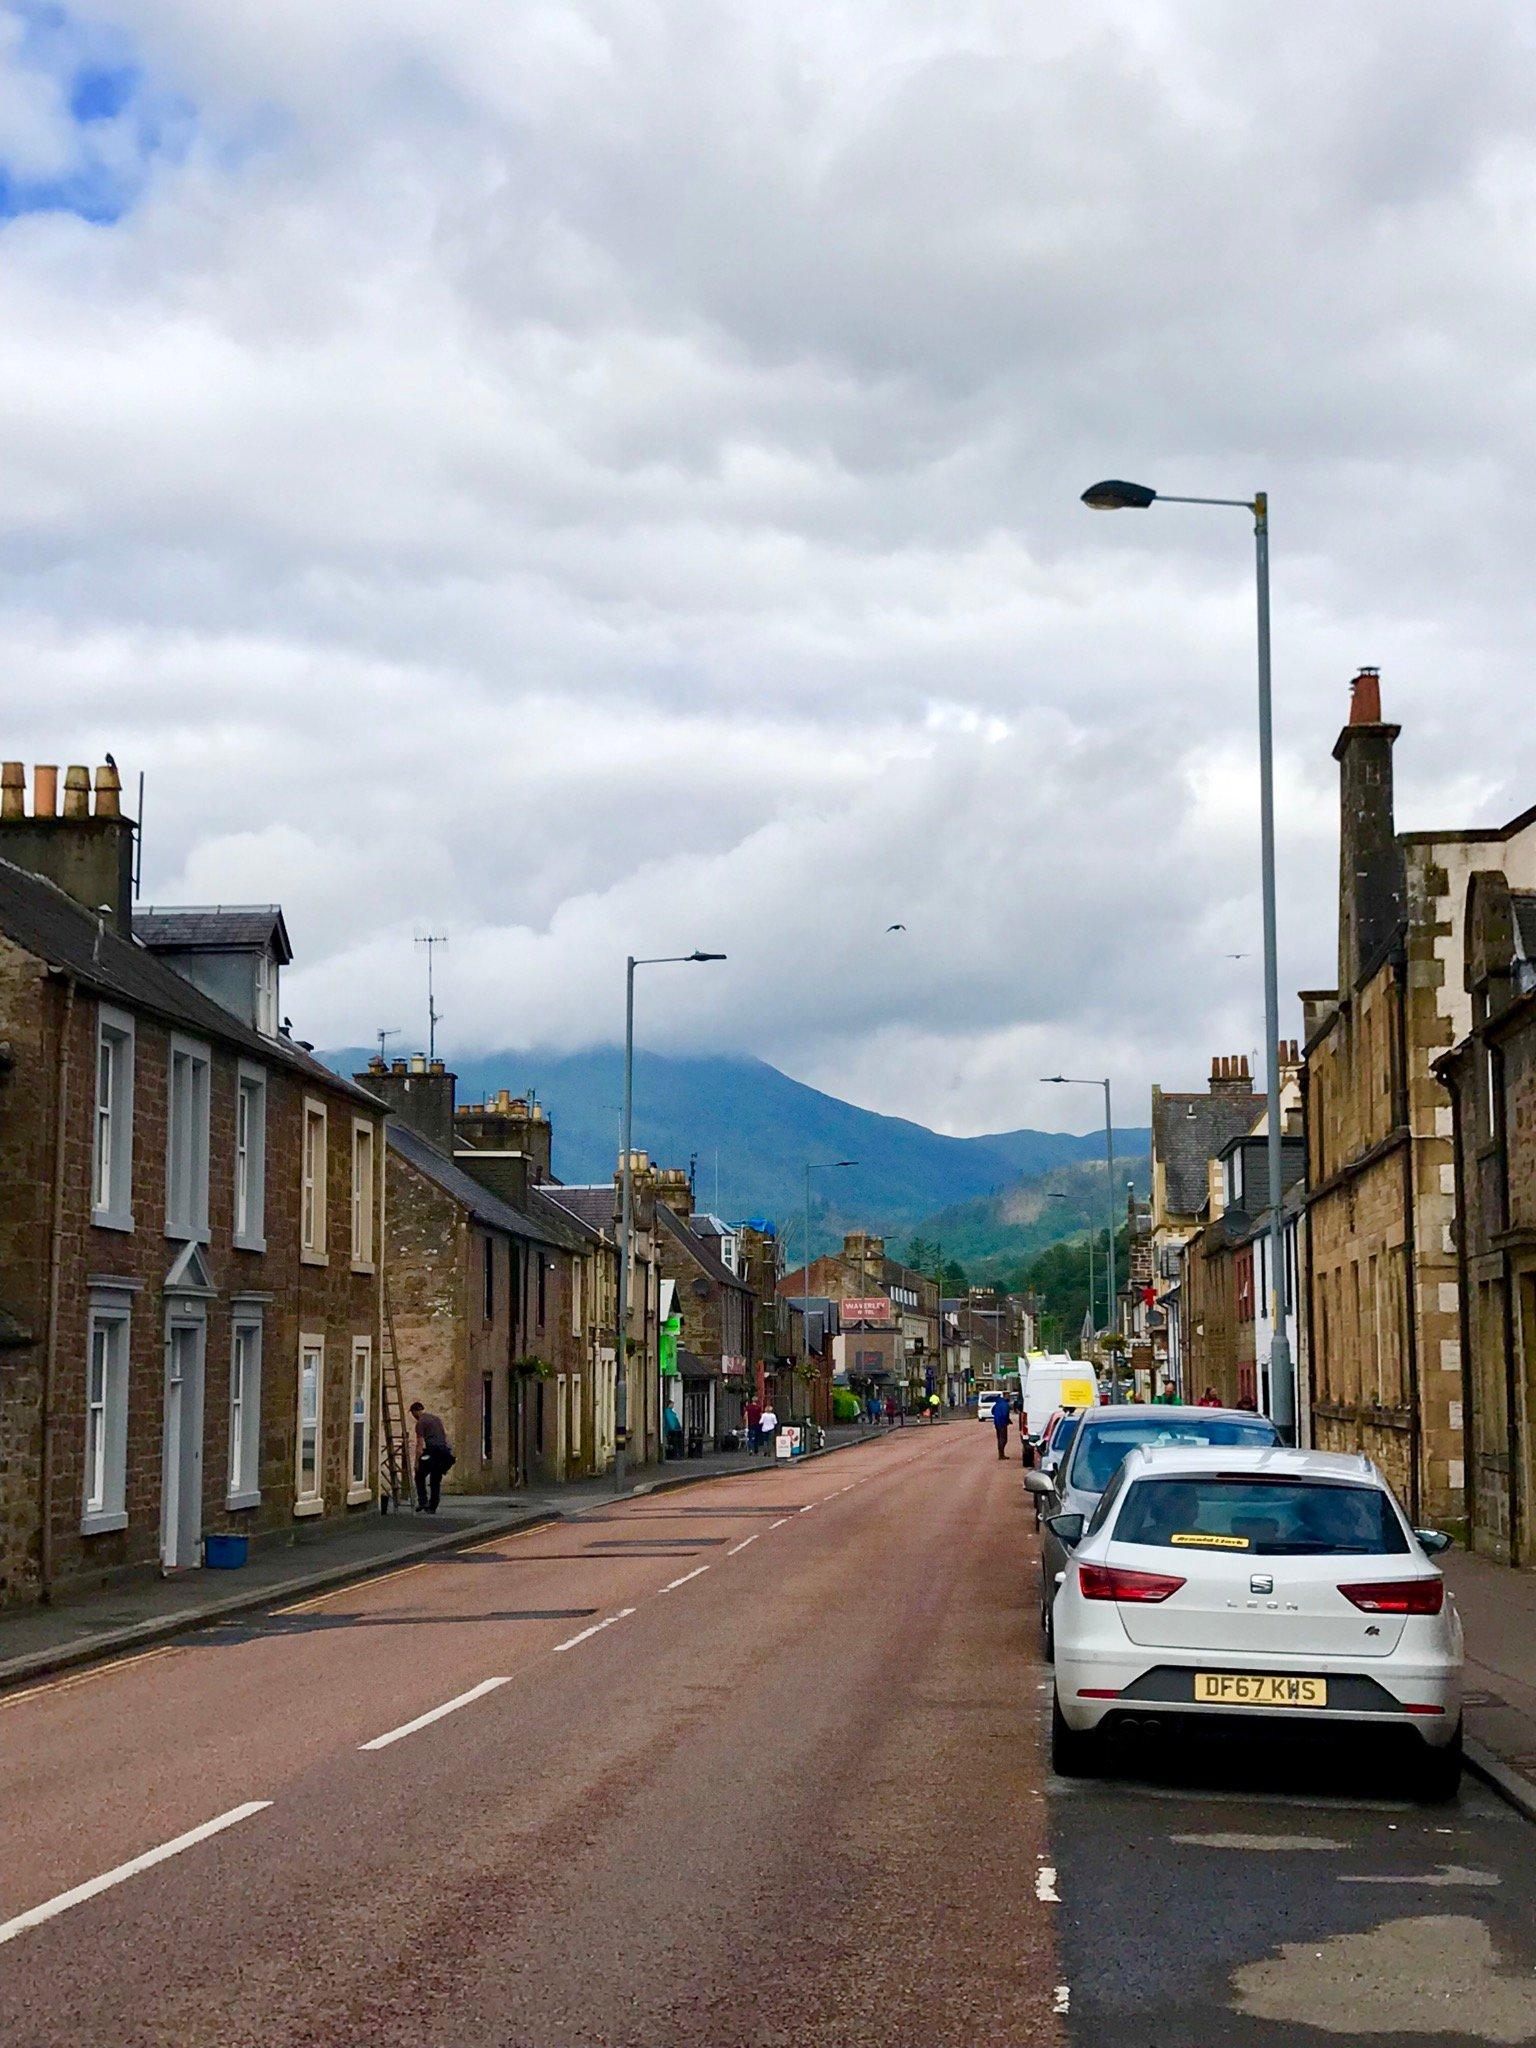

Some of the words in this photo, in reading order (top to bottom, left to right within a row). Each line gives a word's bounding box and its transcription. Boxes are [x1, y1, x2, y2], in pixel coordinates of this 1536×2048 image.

[1227, 1600, 1298, 1611] LEON
[1206, 1676, 1264, 1698] DF67
[1271, 1679, 1316, 1701] KWS
